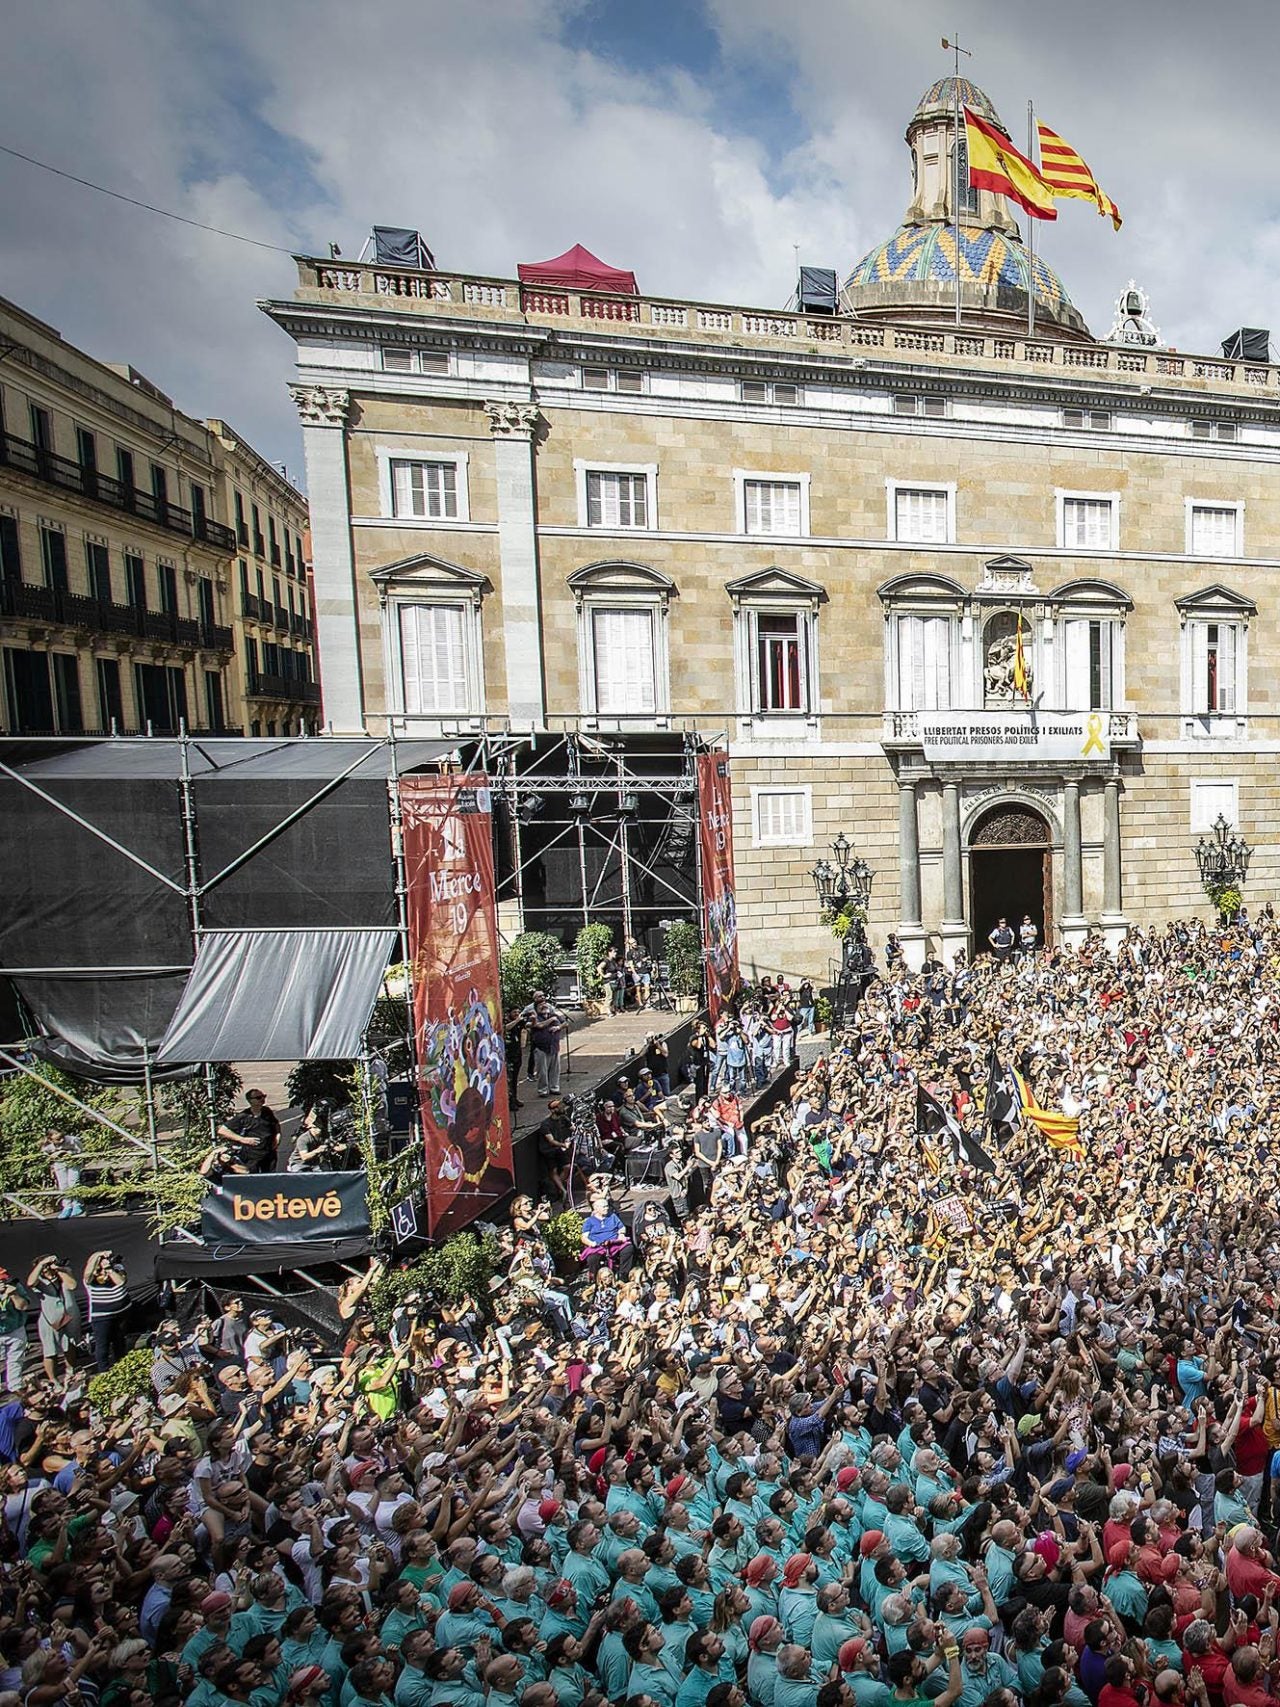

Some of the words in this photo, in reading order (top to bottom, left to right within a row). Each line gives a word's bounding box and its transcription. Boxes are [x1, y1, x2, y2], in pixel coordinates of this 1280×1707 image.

[923, 726, 967, 735] LLIBERTAT
[969, 726, 1001, 735] PRESOS
[1004, 724, 1040, 735] POLÍTICS
[1048, 726, 1083, 735] EXILIATS
[924, 736, 938, 745] FREE
[940, 736, 969, 745] POLITICAL
[970, 736, 1004, 745] PRISONERS
[1005, 736, 1018, 744] AND
[1019, 735, 1038, 744] EXILES
[715, 830, 726, 851] 19
[450, 902, 468, 936] 19
[233, 1190, 342, 1221] betevé
